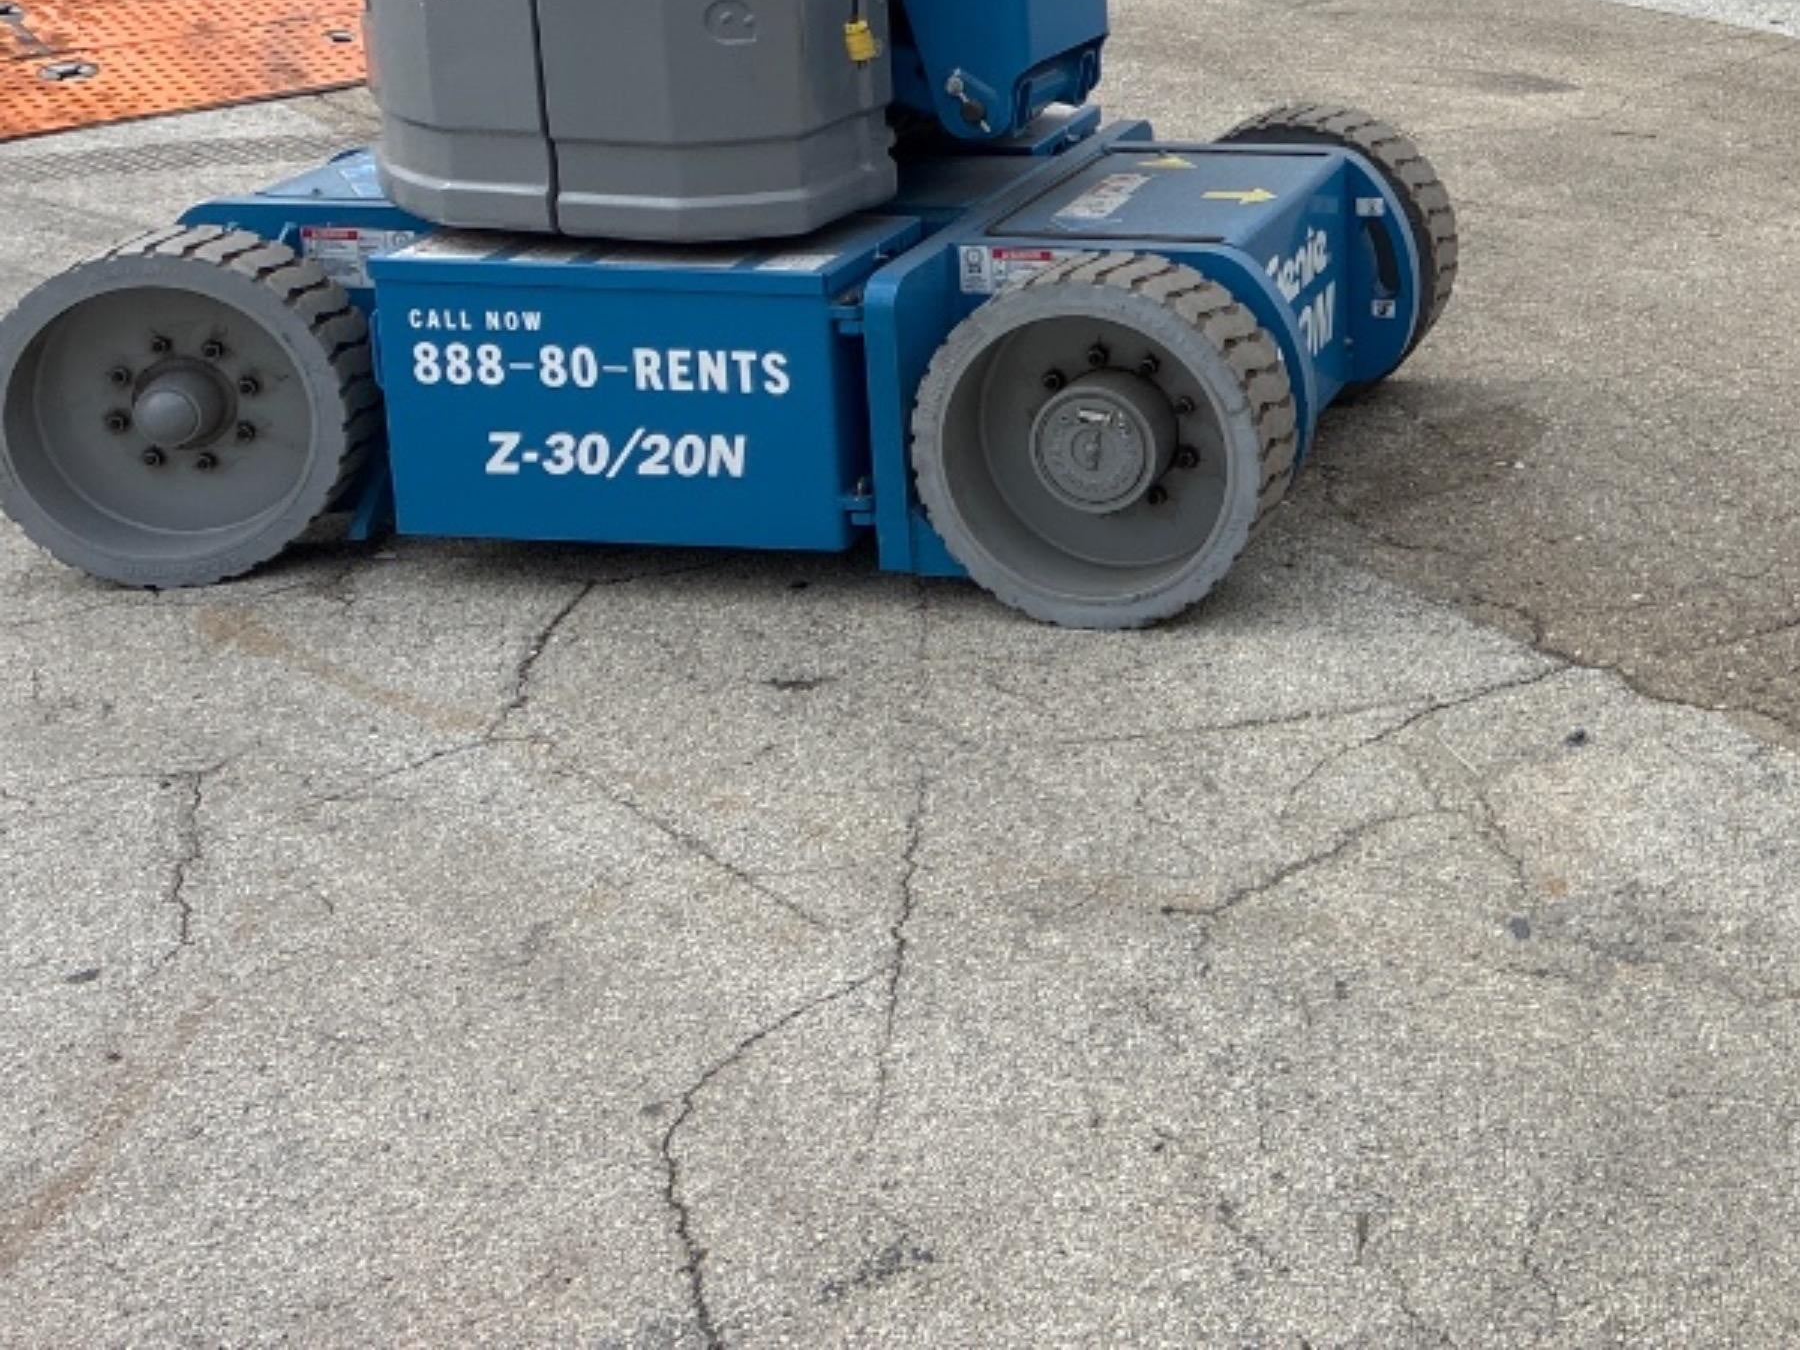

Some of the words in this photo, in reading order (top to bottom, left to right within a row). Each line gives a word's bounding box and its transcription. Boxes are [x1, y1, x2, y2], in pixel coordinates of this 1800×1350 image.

[408, 308, 472, 331] CALL
[485, 310, 542, 332] NOW
[412, 340, 791, 396] 888-80-RENTS
[484, 426, 746, 479] Z-30/20N
